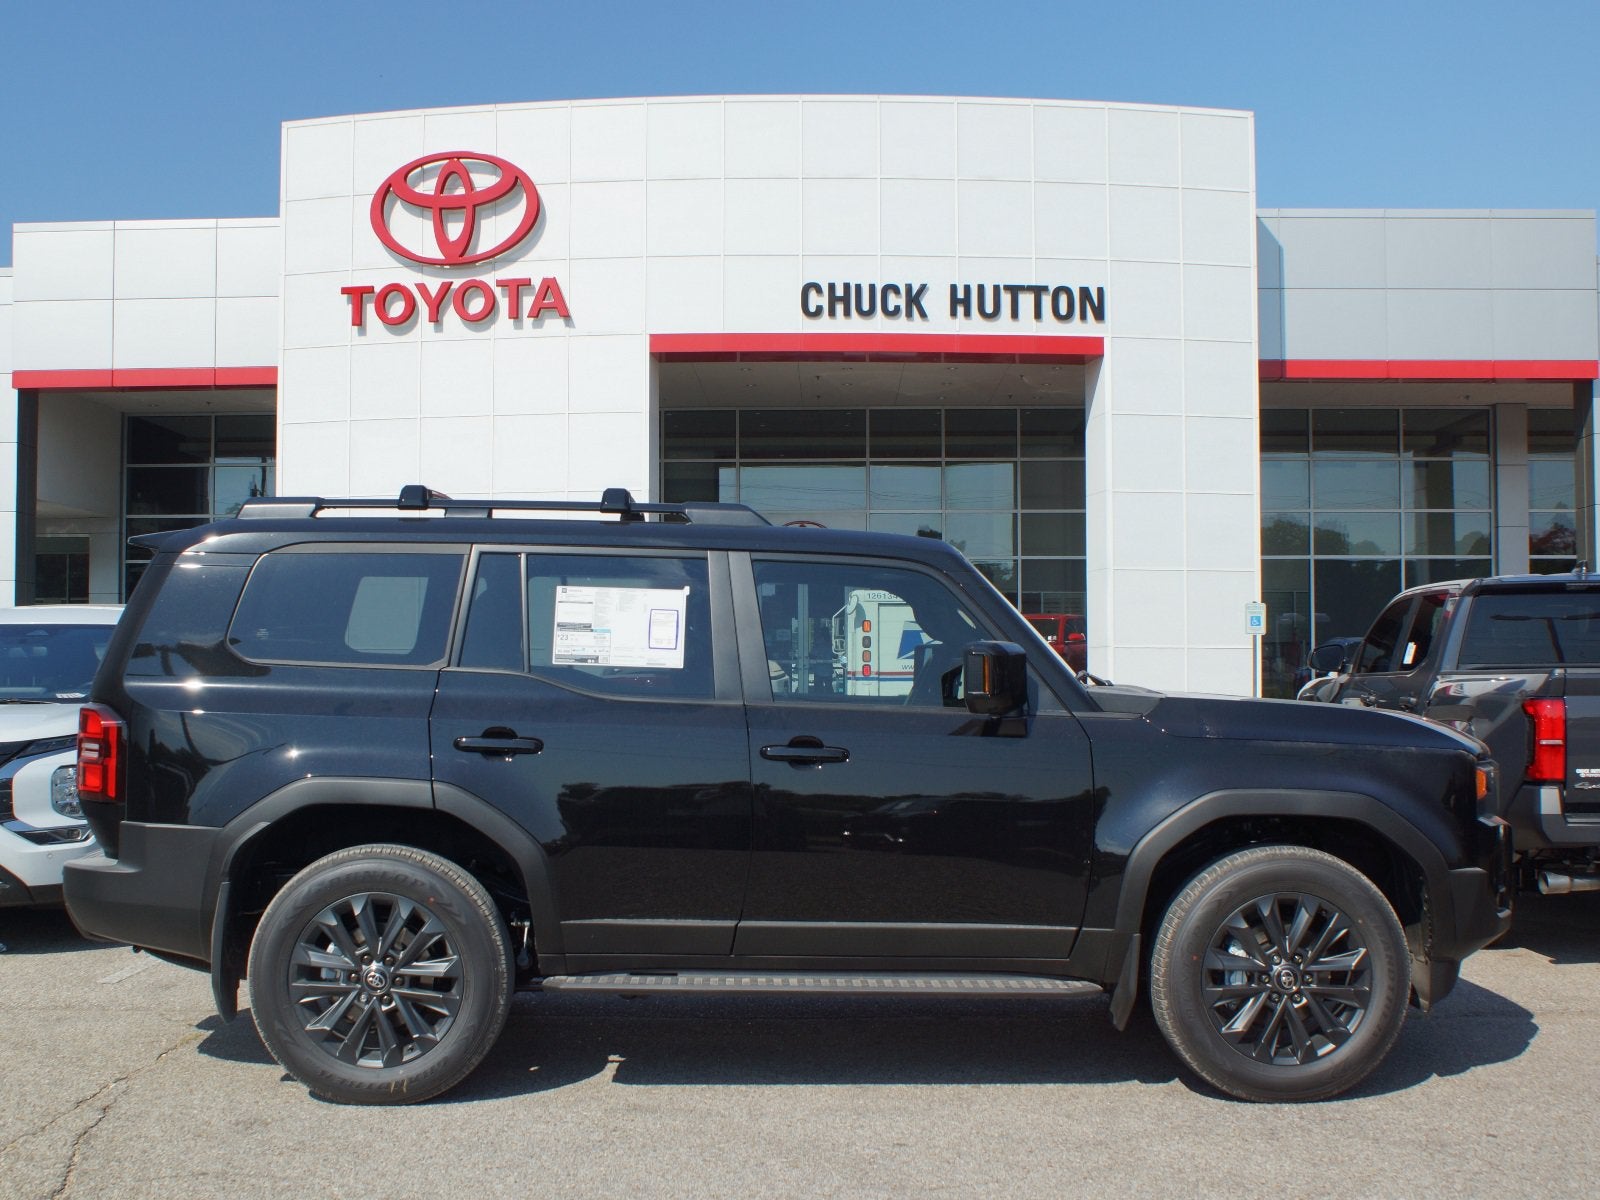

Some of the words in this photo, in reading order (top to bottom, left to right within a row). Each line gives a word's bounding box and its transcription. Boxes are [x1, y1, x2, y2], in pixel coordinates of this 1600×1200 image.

[341, 277, 570, 327] TOYOTA
[801, 281, 928, 319] CHUCK
[949, 283, 1105, 321] HUTTON
